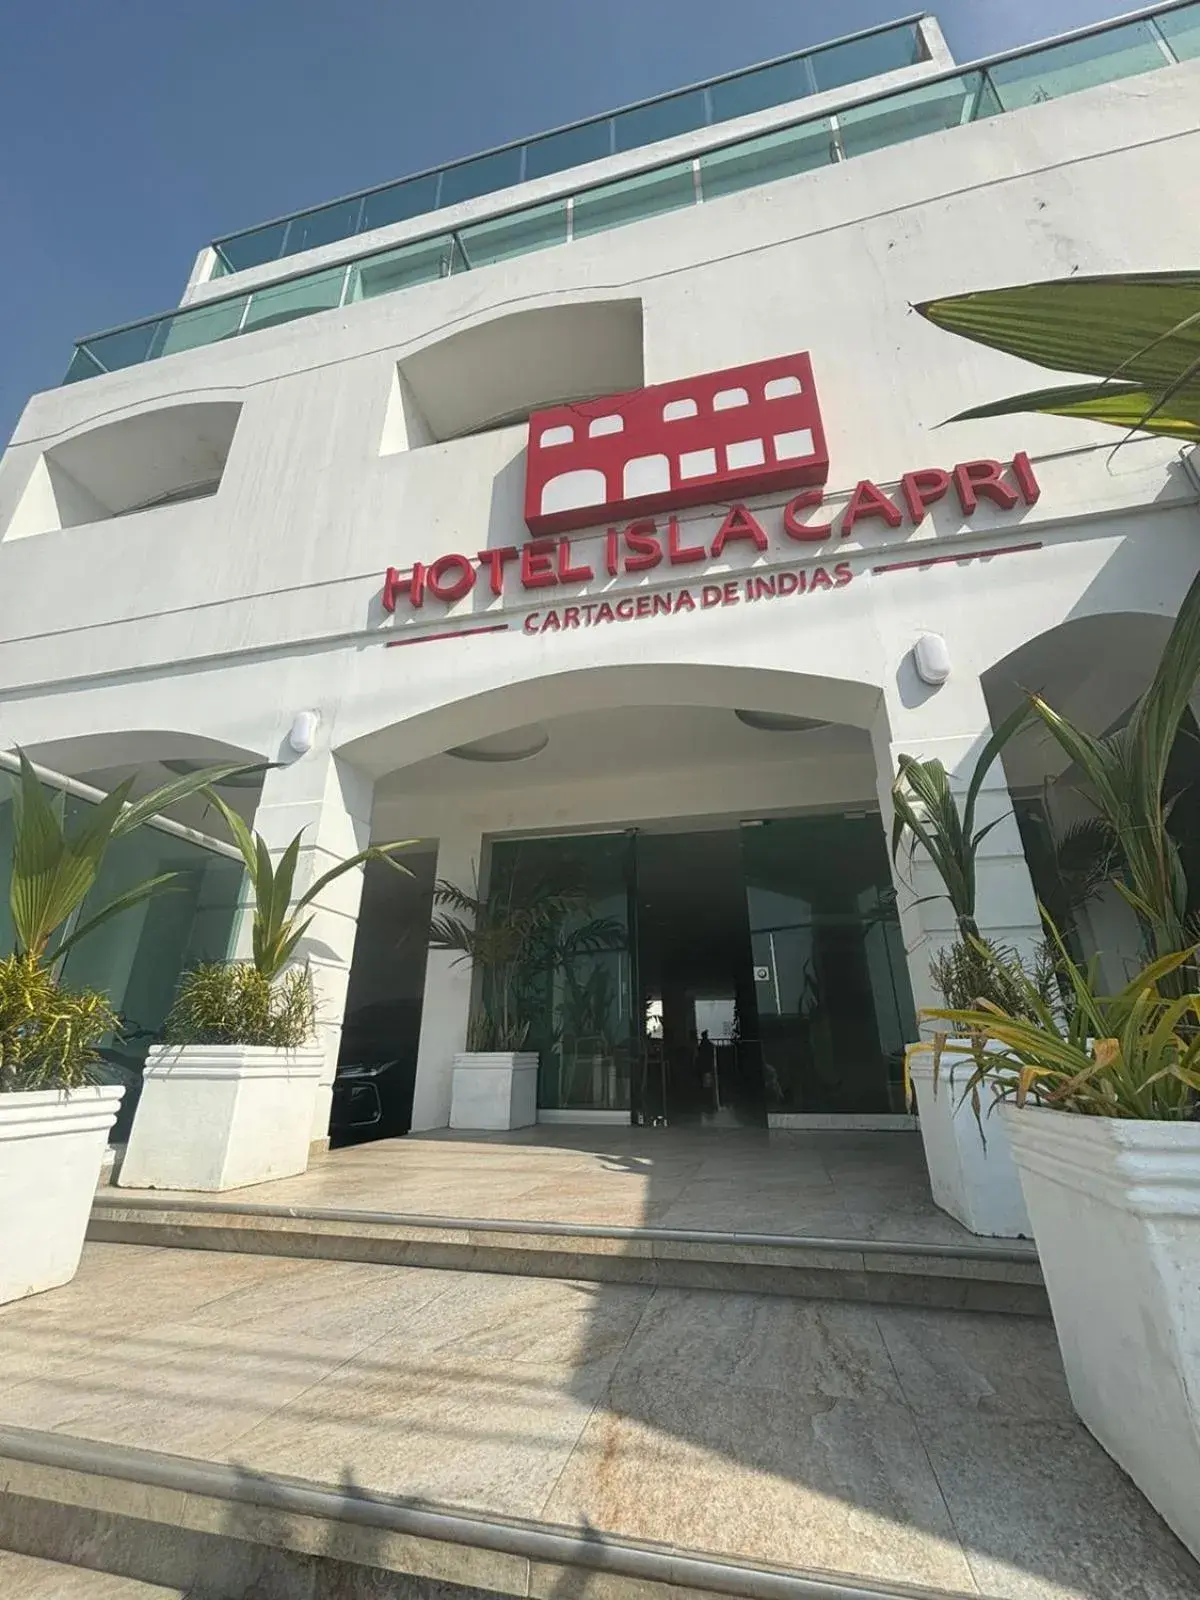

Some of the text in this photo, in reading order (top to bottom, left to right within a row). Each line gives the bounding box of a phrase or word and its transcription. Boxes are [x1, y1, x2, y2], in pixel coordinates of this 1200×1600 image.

[382, 451, 1041, 612] HOTEL ISLA CAPRI
[524, 562, 853, 633] CARTAGENA DE INDIAS
